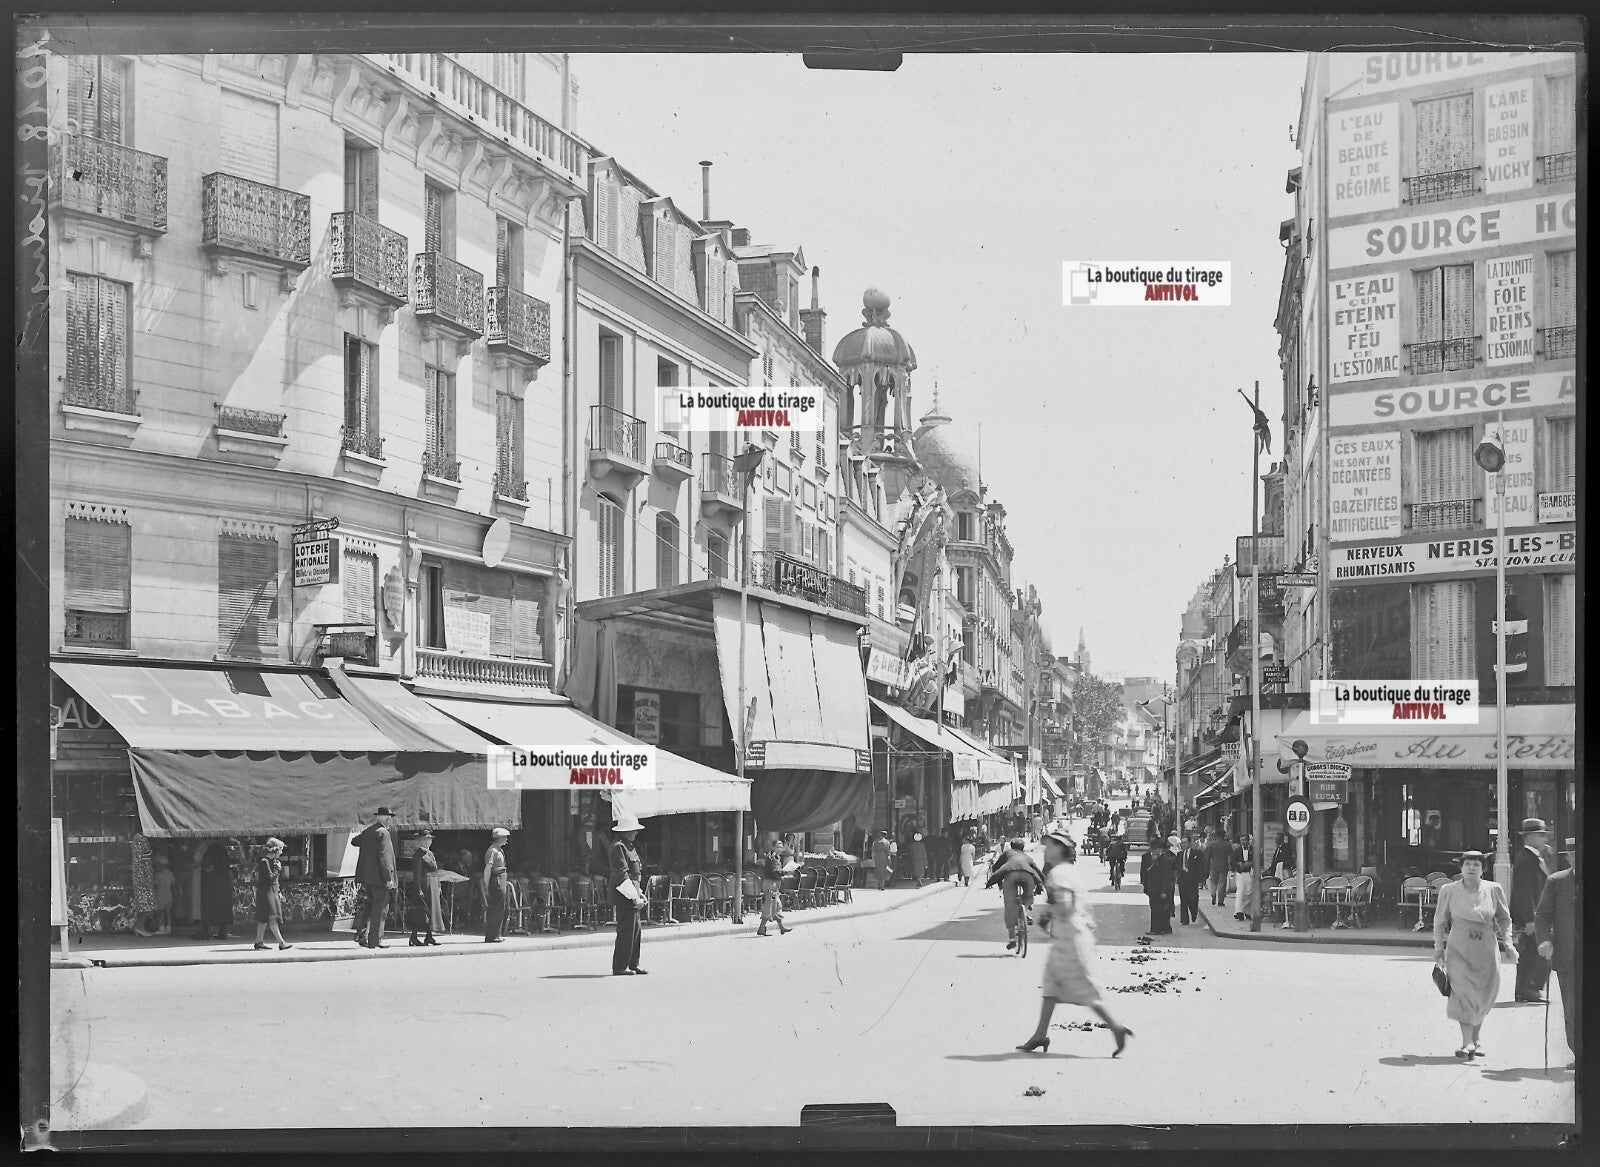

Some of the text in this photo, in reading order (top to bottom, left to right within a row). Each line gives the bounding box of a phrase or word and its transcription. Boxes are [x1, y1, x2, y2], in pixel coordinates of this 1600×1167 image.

[1341, 112, 1383, 131] L'EAU
[1500, 109, 1518, 121] DU
[1353, 130, 1374, 143] DE
[1488, 121, 1529, 143] BASSIN
[1498, 146, 1516, 158] DE
[1350, 162, 1380, 177] ET DE
[1488, 160, 1530, 182] VICHY
[1366, 210, 1500, 257] SOURCE
[1336, 277, 1394, 299] L'EAU
[1498, 277, 1520, 286] DU
[1349, 296, 1377, 307] QUI
[1494, 286, 1526, 305] FOIE
[1496, 304, 1522, 314] DES
[1353, 323, 1374, 332] LE
[1489, 311, 1532, 332] REINS
[1348, 331, 1380, 350] FEU
[1500, 332, 1517, 341] DE
[1353, 350, 1373, 359] DE
[1333, 355, 1399, 378] L'ESTOMAC
[1373, 380, 1531, 417] SOURCE
[1334, 440, 1394, 455] CES EAUX
[1346, 456, 1372, 468] SONT
[1376, 455, 1390, 465] NI
[1353, 487, 1368, 496] NI
[295, 543, 329, 557] LOTERIE
[1347, 545, 1403, 561] NERVEUX
[1427, 539, 1494, 559] NERIS
[295, 554, 329, 568] NATIONALE
[1533, 555, 1547, 565] DE
[1336, 561, 1415, 579] RHUMATISANTS
[111, 693, 335, 720] TABAC
[1395, 736, 1466, 759] Au
